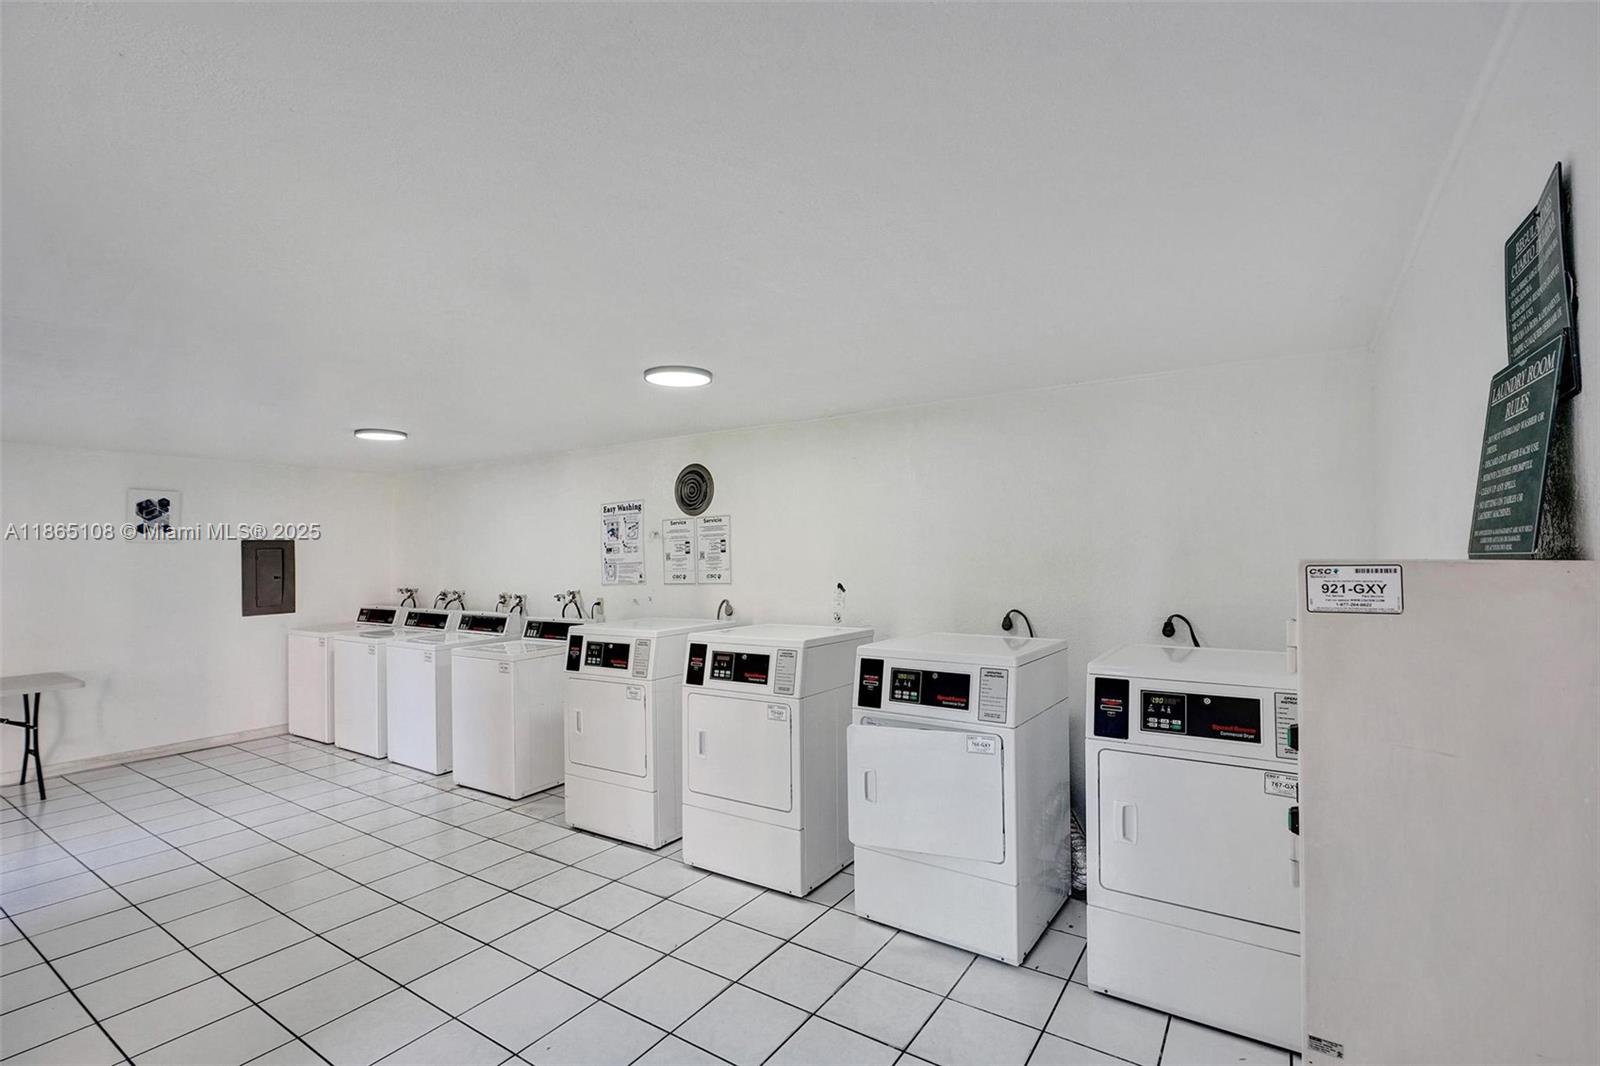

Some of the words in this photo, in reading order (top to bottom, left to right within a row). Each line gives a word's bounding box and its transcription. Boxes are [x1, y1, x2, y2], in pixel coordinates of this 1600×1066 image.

[1490, 366, 1528, 404] LAUNDRY
[1526, 349, 1556, 384] ROOM
[1504, 390, 1530, 419] RULES
[1520, 414, 1537, 430] WASHER
[1537, 410, 1545, 423] OR
[603, 505, 616, 514] Easy
[617, 503, 642, 513] Washing
[1321, 584, 1387, 594] 921-GXY
